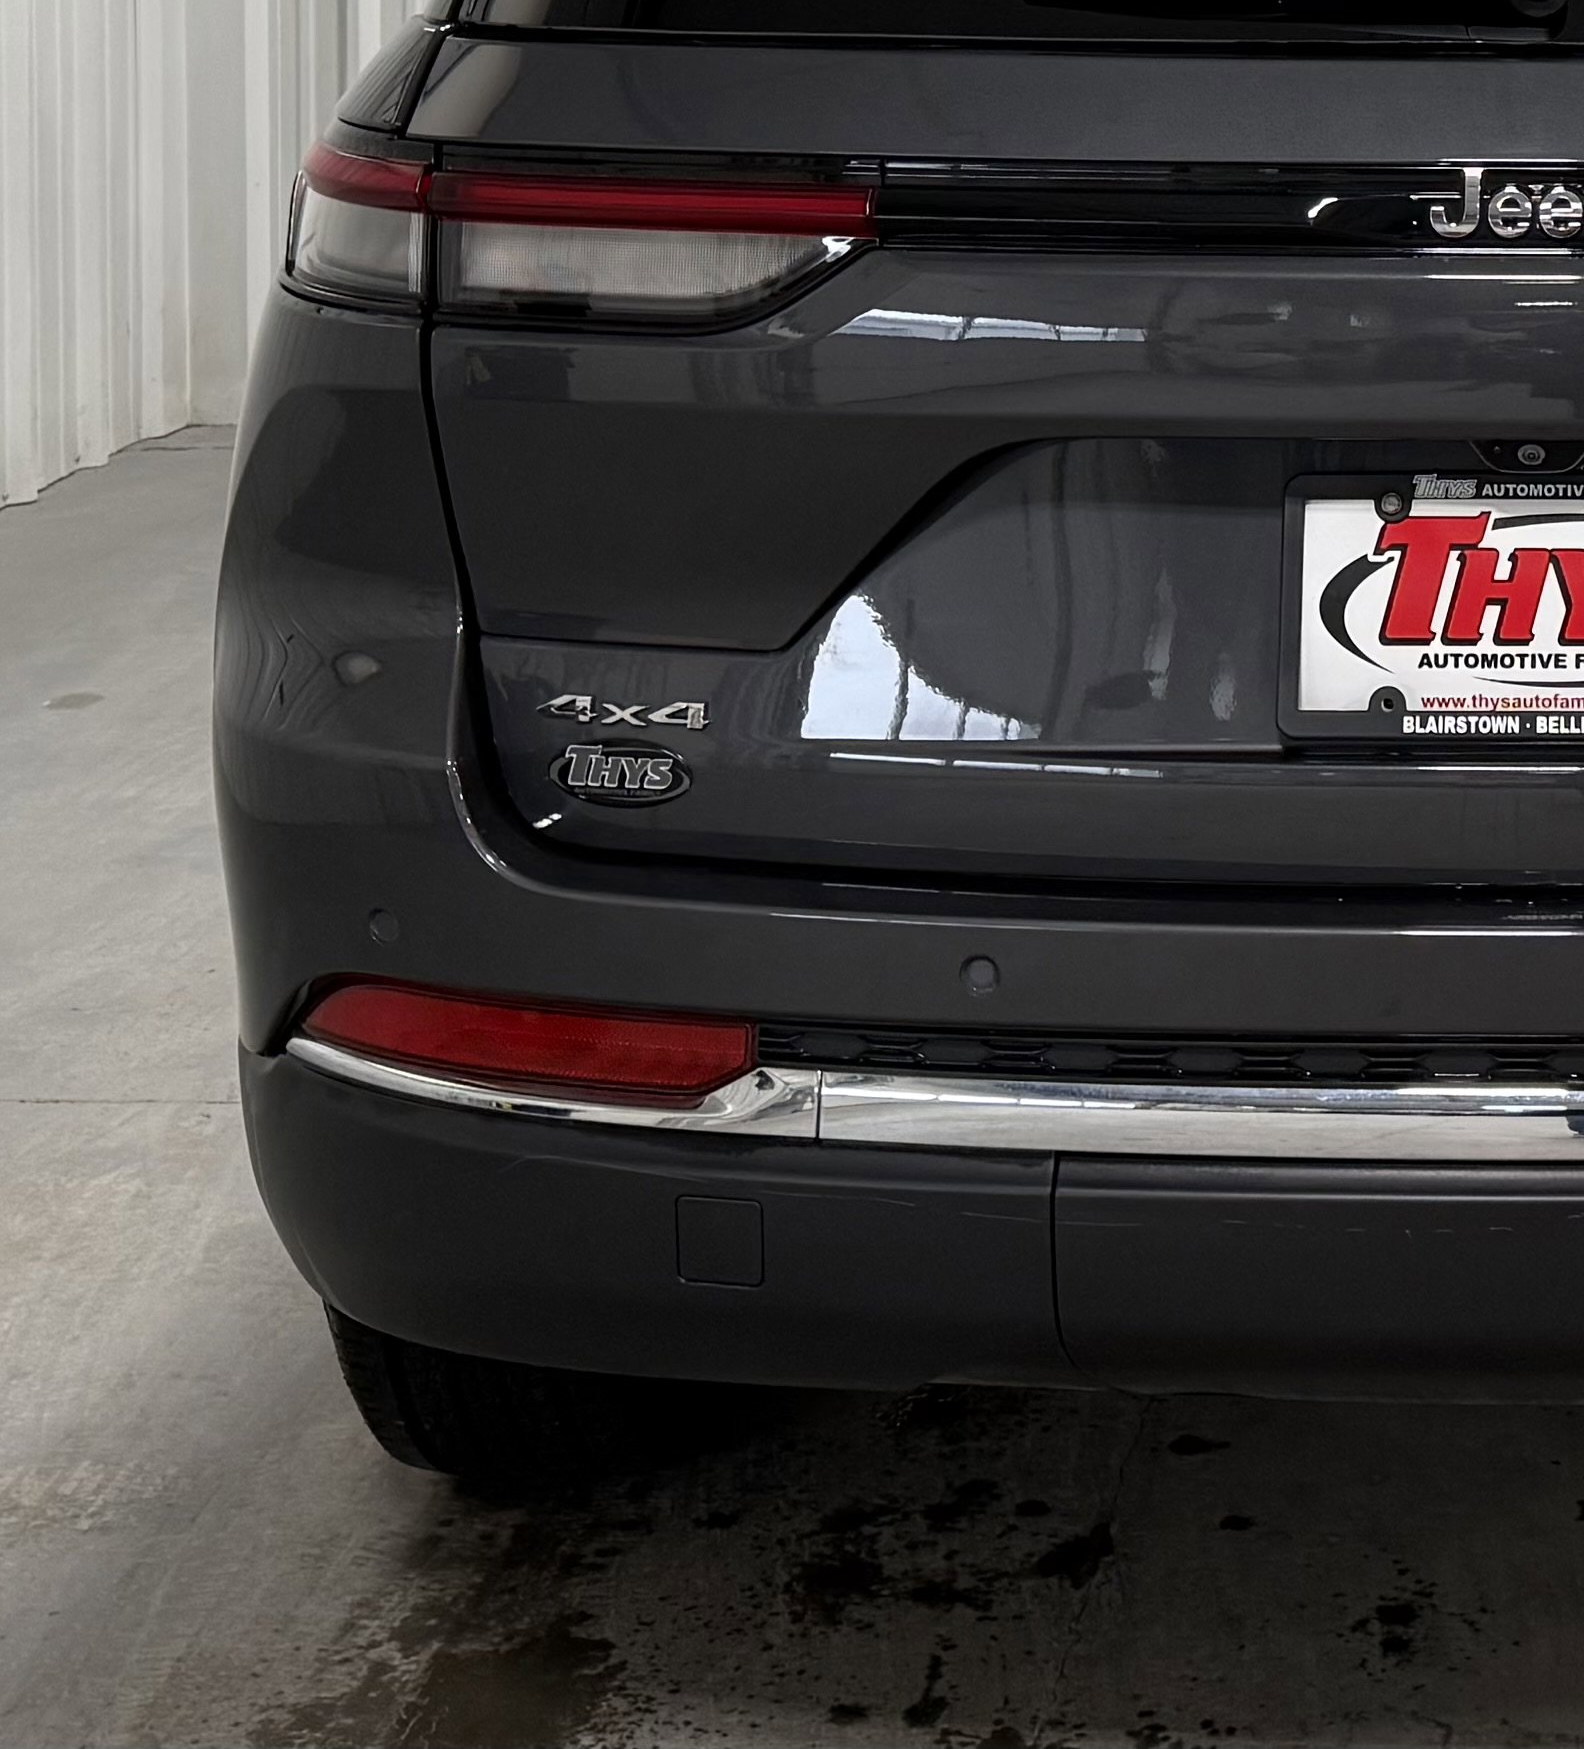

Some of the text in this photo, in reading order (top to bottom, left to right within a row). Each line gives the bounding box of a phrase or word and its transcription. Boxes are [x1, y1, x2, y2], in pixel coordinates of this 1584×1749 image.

[1412, 474, 1477, 498] THYS
[1418, 653, 1569, 670] AUTOMOTIVE
[536, 694, 712, 729] 4x4
[1403, 715, 1520, 735] BLAIRSTOWN
[565, 744, 673, 790] THYS
